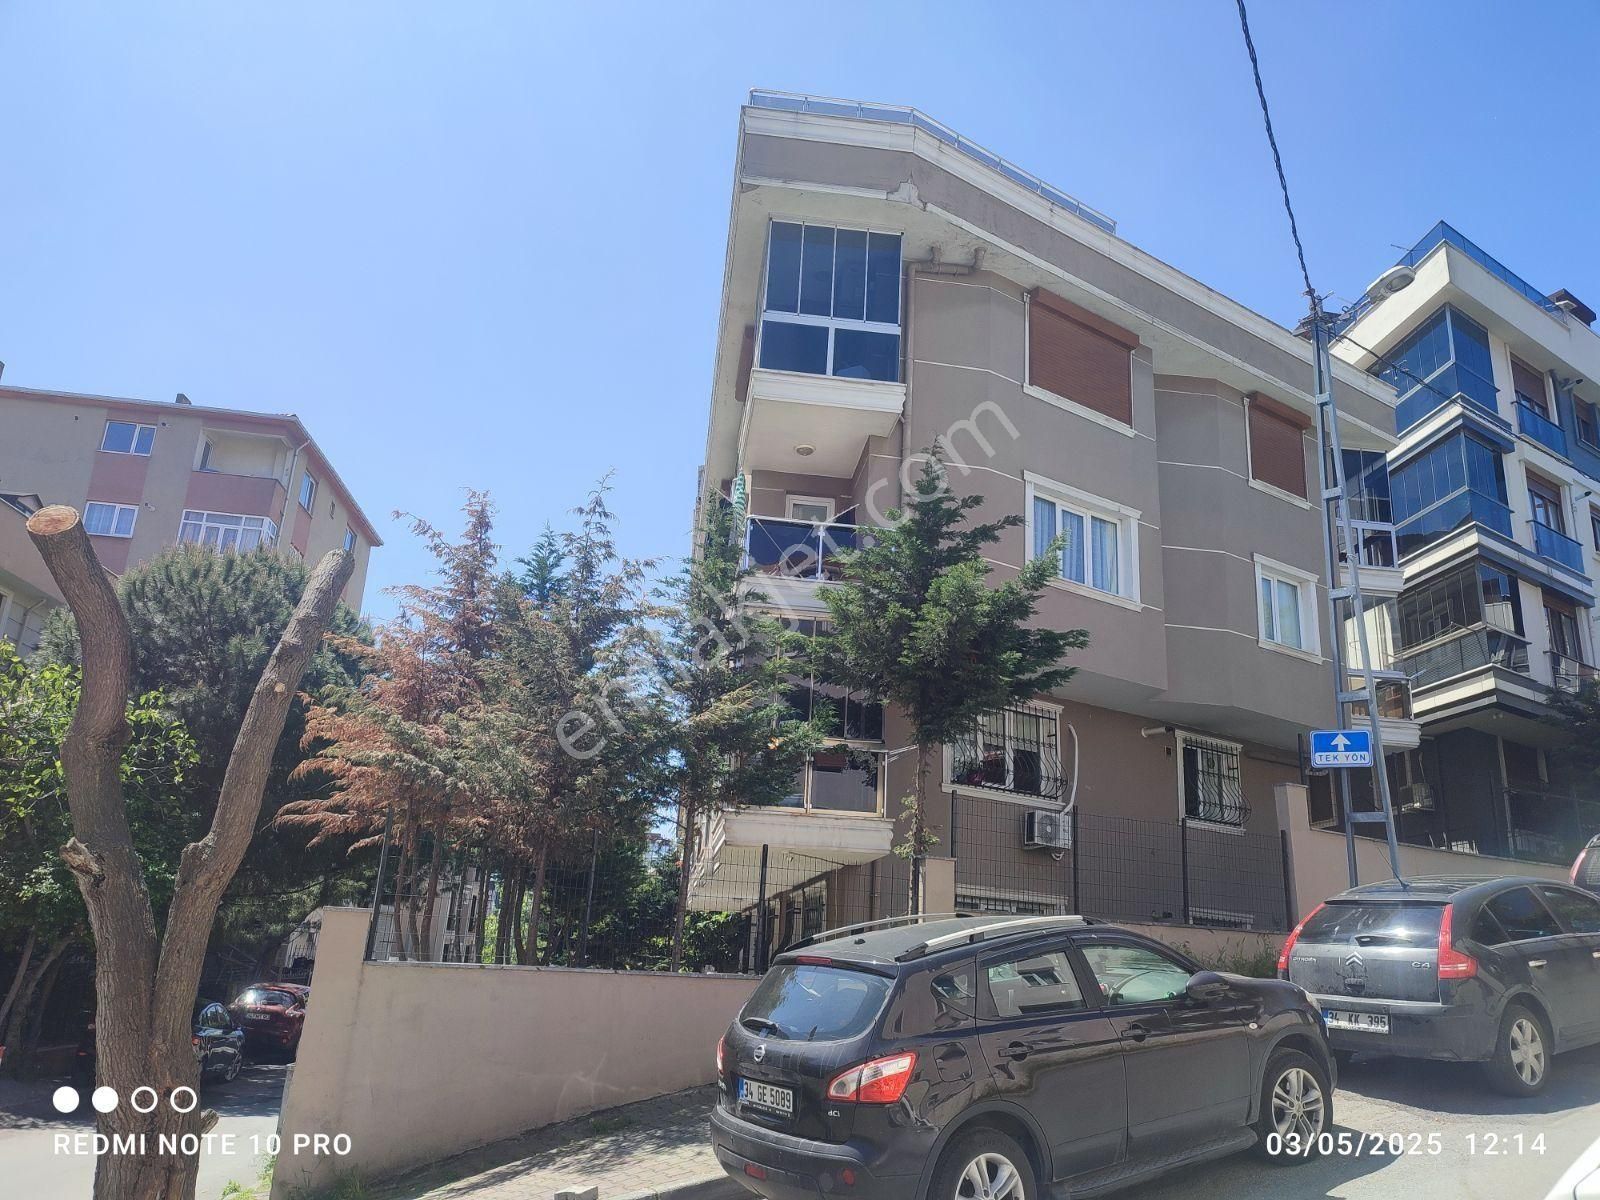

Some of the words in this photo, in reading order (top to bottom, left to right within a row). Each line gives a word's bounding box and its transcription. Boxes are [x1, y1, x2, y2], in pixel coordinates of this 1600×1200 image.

[1318, 754, 1338, 762] TEK
[1345, 752, 1366, 762] YÖN
[1411, 961, 1431, 969] C4
[1328, 1011, 1340, 1024] 34
[1348, 1013, 1360, 1026] KK
[1367, 1015, 1386, 1028] 395
[744, 1081, 753, 1100] 34
[757, 1084, 767, 1103] GE
[770, 1087, 791, 1110] 5089
[827, 1109, 841, 1118] dCi
